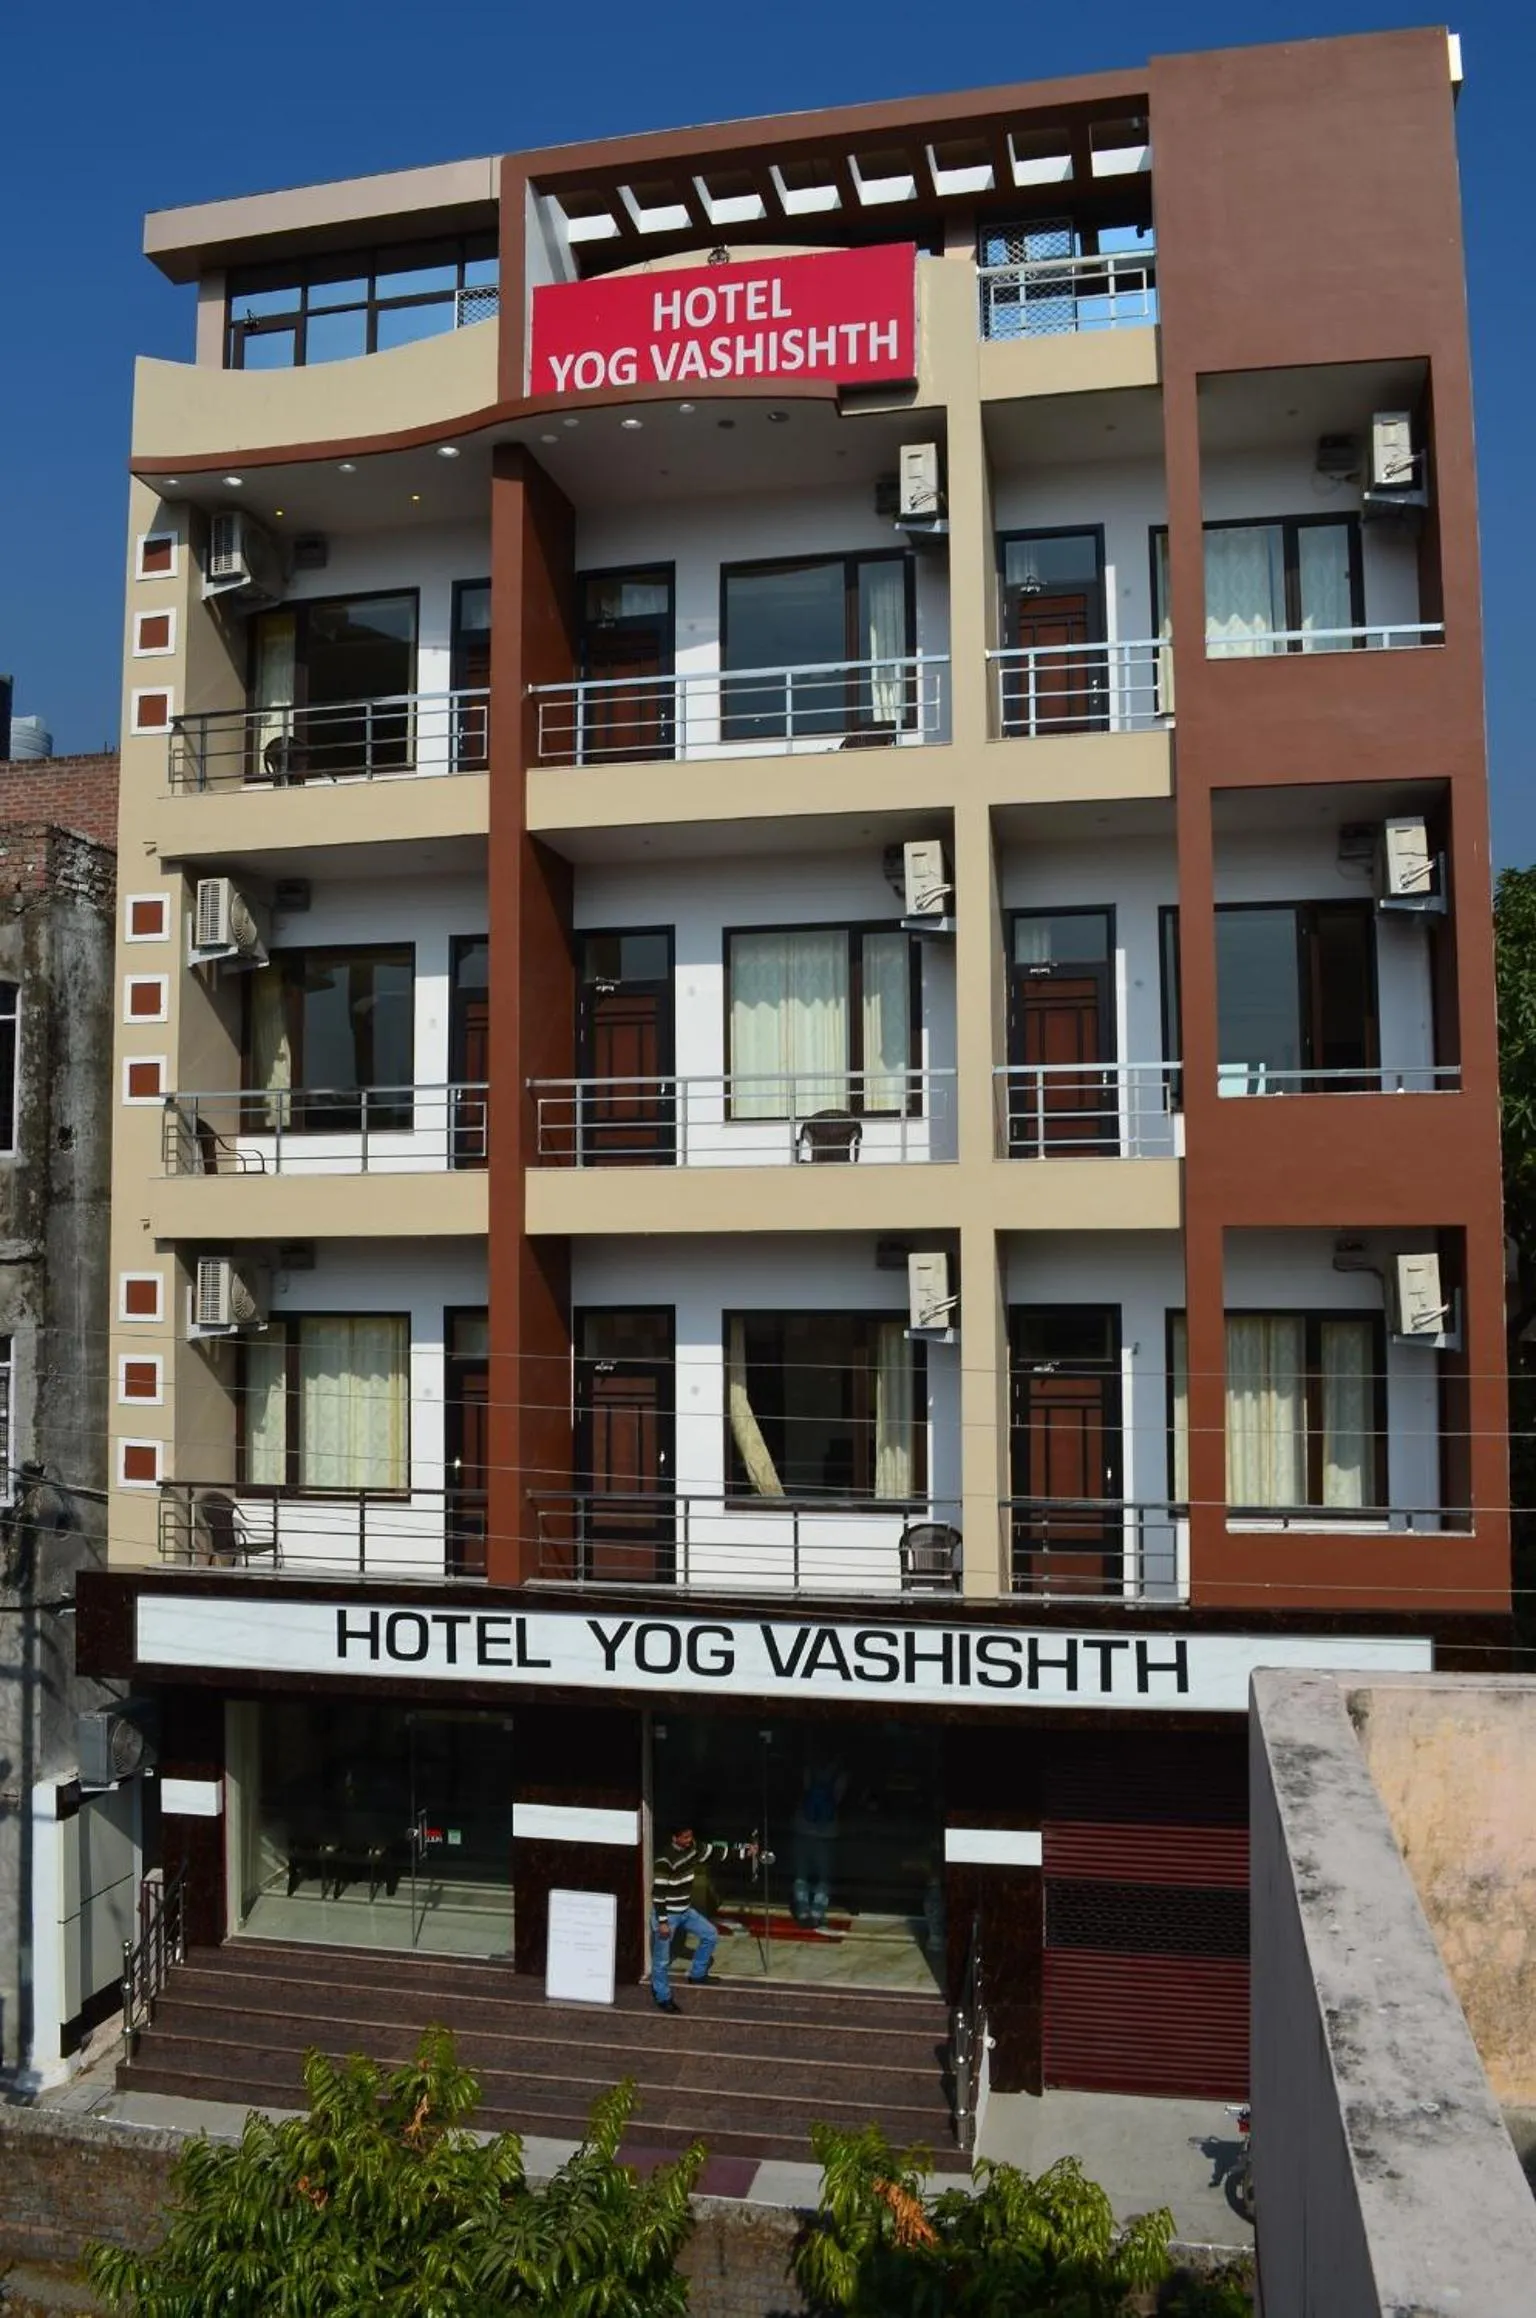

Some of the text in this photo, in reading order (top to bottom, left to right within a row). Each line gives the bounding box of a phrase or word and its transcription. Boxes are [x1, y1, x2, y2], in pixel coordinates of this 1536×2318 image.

[653, 278, 792, 332] HOTEL
[548, 319, 898, 393] YOG VASHISHTH
[336, 1609, 1189, 1694] HOTEL YOG VASHISHTH
